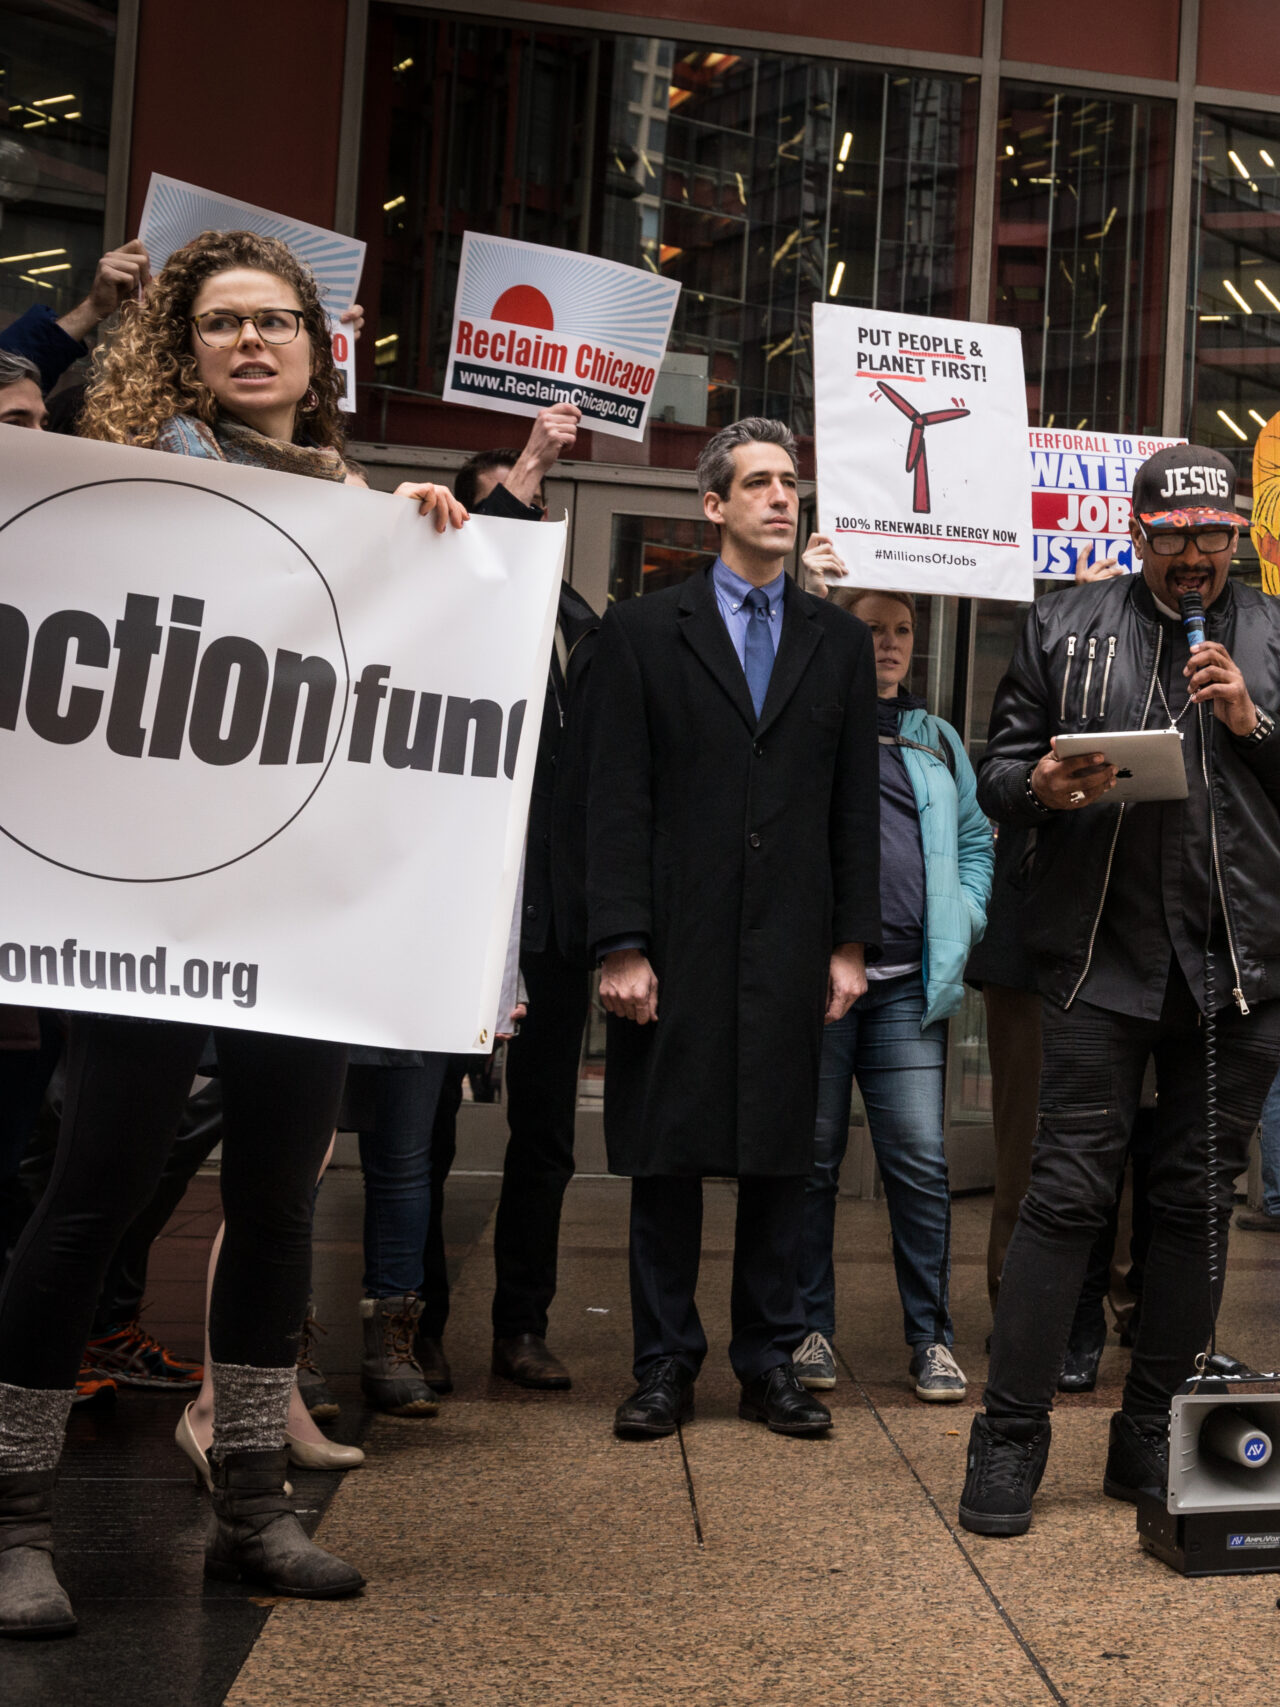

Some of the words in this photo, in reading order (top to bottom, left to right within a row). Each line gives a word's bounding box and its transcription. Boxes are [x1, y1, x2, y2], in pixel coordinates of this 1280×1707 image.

[456, 320, 568, 374] Reclaim
[575, 344, 656, 395] Chicago
[858, 327, 892, 346] PUT
[898, 332, 965, 355] PEOPLE
[969, 341, 983, 358] &
[857, 352, 925, 376] PLANET
[932, 361, 987, 382] FIRST!
[459, 370, 639, 425] www.ReclaimChicago.org
[1114, 439, 1133, 455] TO
[1160, 466, 1229, 498] JESUS
[835, 517, 871, 530] 100%
[874, 520, 942, 536] RENEWABLE
[946, 525, 989, 540] ENERGY
[993, 530, 1017, 543] NOW
[875, 549, 977, 567] #MillionsOfJobs
